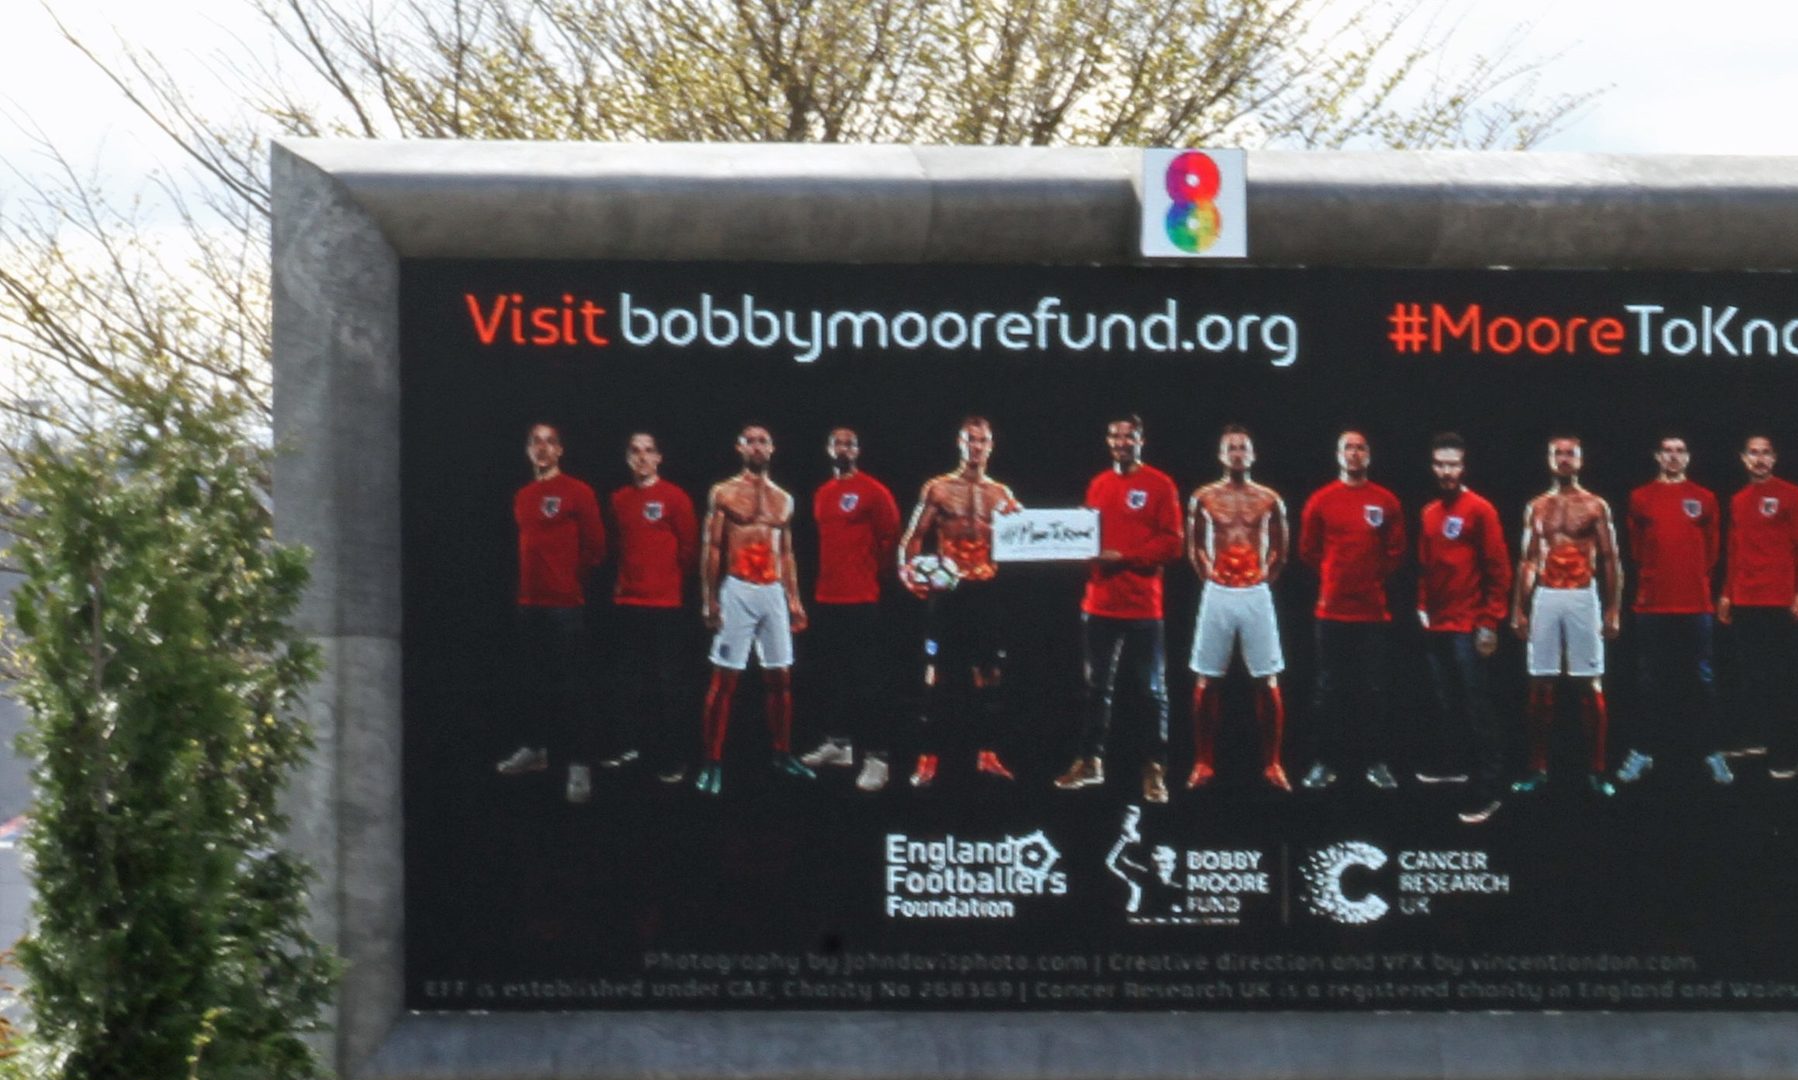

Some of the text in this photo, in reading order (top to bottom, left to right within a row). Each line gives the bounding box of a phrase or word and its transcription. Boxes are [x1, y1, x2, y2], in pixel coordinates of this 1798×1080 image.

[464, 293, 1299, 367] Visit bobbymoorefund.org
[885, 833, 1016, 870] England
[1186, 849, 1263, 871] BOBBY
[1399, 850, 1488, 871] CANCER
[885, 865, 1067, 897] Footballers
[1186, 872, 1270, 893] MOORE
[1399, 872, 1510, 893] RESEARCH
[885, 896, 1016, 919] Foundation
[1186, 894, 1241, 914] FUND
[1399, 896, 1430, 916] UK
[643, 951, 800, 975] Photography
[806, 952, 838, 976] by
[1107, 954, 1209, 972] Creative
[1215, 953, 1324, 972] direction
[1329, 954, 1374, 972] and
[1381, 955, 1426, 972] VFX
[1430, 954, 1465, 976] by
[501, 979, 645, 998] established
[651, 980, 720, 998] under
[782, 980, 873, 1002] Charity
[1034, 982, 1116, 999] Cancer
[1122, 982, 1234, 999] Research
[1238, 983, 1272, 999] UK
[1305, 985, 1321, 999] a
[1327, 982, 1449, 1003] registered
[1456, 981, 1543, 1003] charity
[1548, 984, 1571, 999] in
[1577, 981, 1674, 1003] England
[1679, 982, 1724, 999] and
